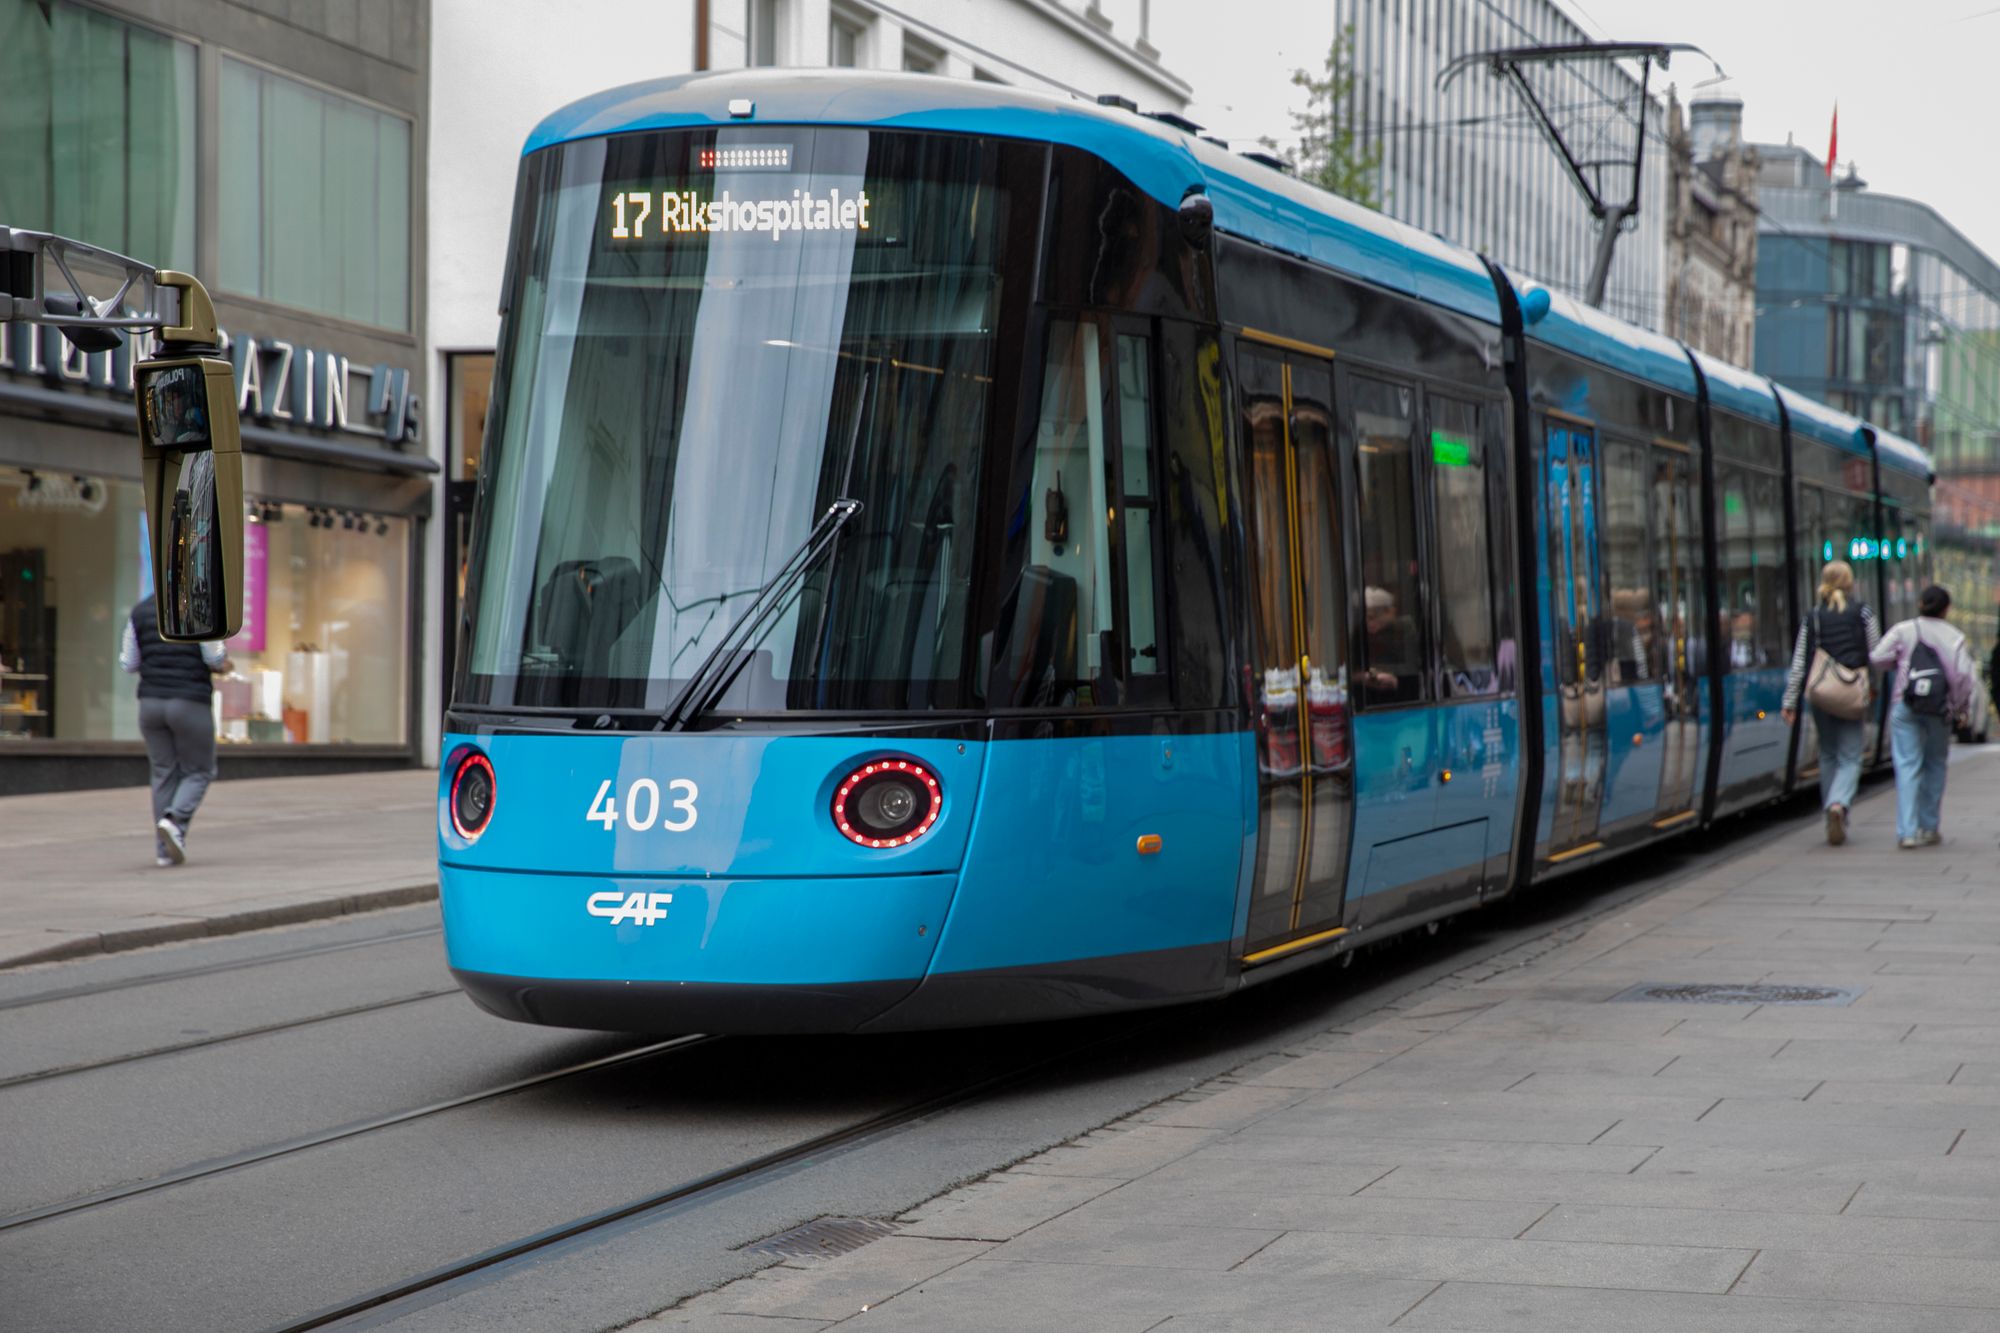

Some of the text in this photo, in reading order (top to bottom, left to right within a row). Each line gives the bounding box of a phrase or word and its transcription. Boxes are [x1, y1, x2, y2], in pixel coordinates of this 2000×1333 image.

[612, 188, 870, 241] 17 Rikshospitalet
[586, 778, 699, 832] 403
[586, 891, 673, 926] CAF
